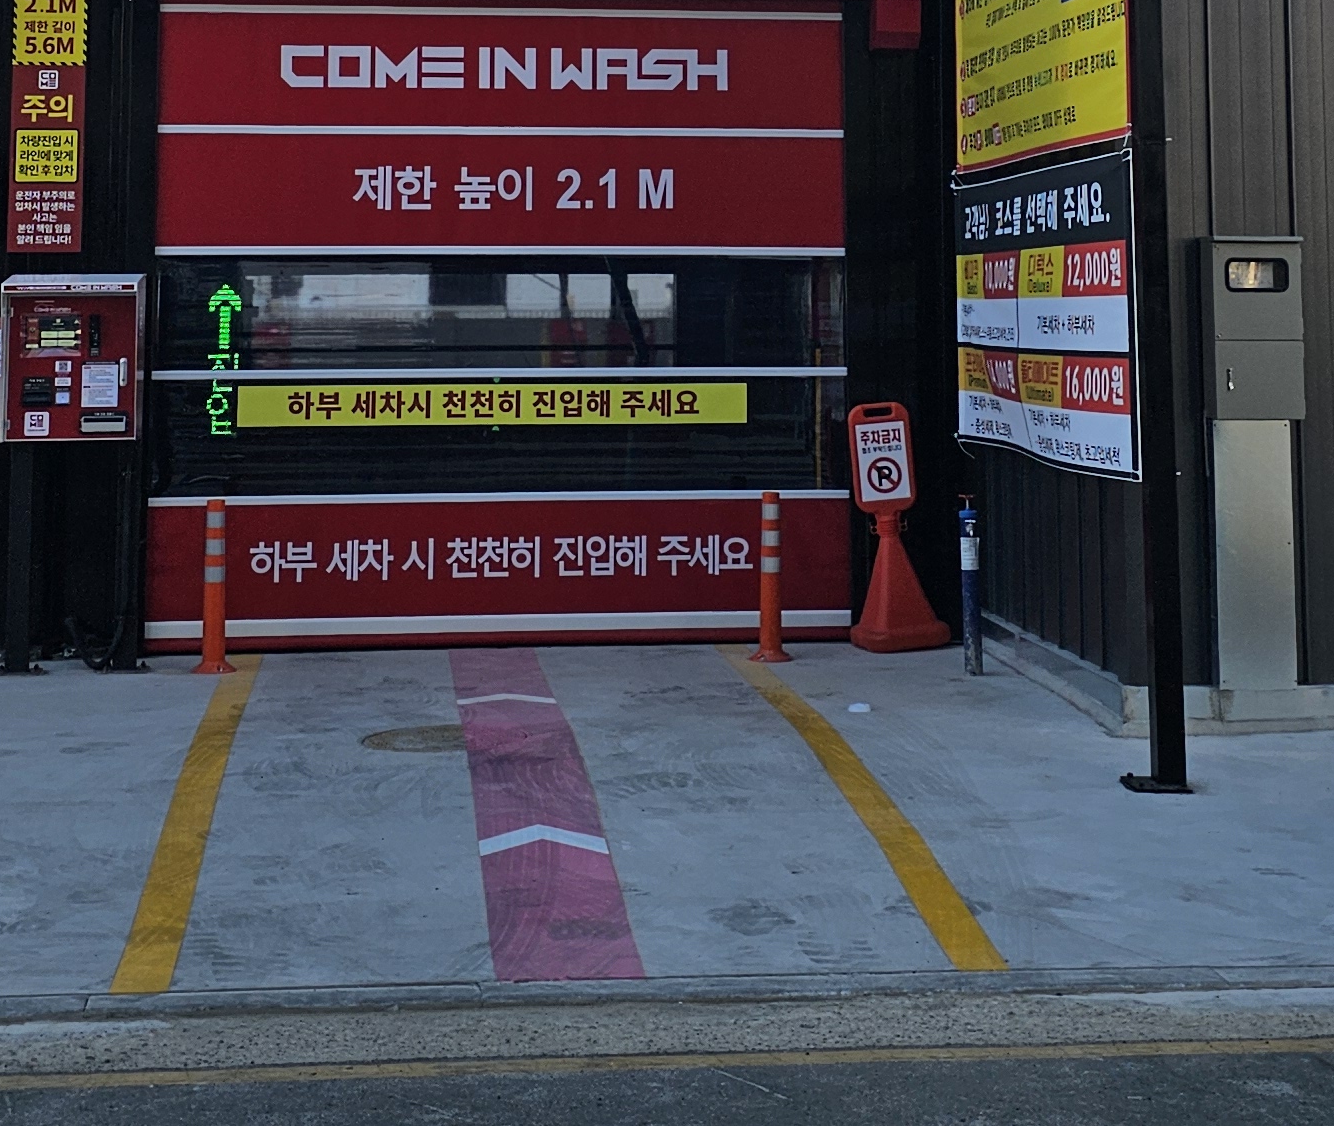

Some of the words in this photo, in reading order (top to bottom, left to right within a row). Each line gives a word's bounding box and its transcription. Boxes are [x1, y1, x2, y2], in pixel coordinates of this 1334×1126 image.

[24, 21, 48, 34] 제한
[52, 21, 75, 34] 길이
[24, 36, 74, 55] 5.6M
[280, 44, 465, 89] COME
[478, 46, 537, 90] IN
[550, 48, 729, 92] WASH
[21, 94, 73, 123] 주의
[20, 135, 61, 147] 차량진입
[63, 135, 73, 147] 시
[20, 150, 51, 162] 라인에
[53, 150, 74, 162] 맞게
[18, 164, 39, 176] 확인
[41, 164, 52, 176] 후
[53, 164, 74, 176] 입차
[15, 190, 41, 201] 운전자
[42, 190, 76, 201] 부주의로
[352, 166, 436, 211] 제한
[453, 166, 533, 211] 높이
[555, 168, 617, 211] 2.1
[638, 169, 675, 210] M
[15, 201, 41, 211] 입차시
[42, 201, 76, 212] 발생하는
[965, 203, 990, 240] 고객님!
[995, 196, 1022, 236] 코스를
[1026, 189, 1058, 234] 선택해
[1063, 182, 1111, 229] 주세요.
[32, 212, 58, 222] 사고는
[17, 223, 35, 234] 본인
[36, 223, 53, 234] 책임
[16, 235, 34, 245] 알려
[34, 235, 72, 245] 드립니다!
[1027, 252, 1054, 277] 디럭스
[1067, 247, 1121, 292] 12,000원
[1037, 315, 1060, 335] 기본세차
[1067, 314, 1095, 335] 하부세차
[1065, 365, 1124, 406] 16,000원
[287, 390, 343, 420] 하부
[351, 390, 433, 420] 세차시
[441, 389, 523, 420] 천천히
[531, 389, 611, 419] 진입해
[619, 389, 701, 419] 주세요
[860, 427, 902, 446] 주차금지
[248, 539, 318, 583] 하부
[325, 537, 395, 583] 세차
[400, 537, 435, 581] 시
[445, 535, 542, 579] 천천히
[553, 534, 649, 578] 진입해
[656, 533, 755, 576] 주세요
